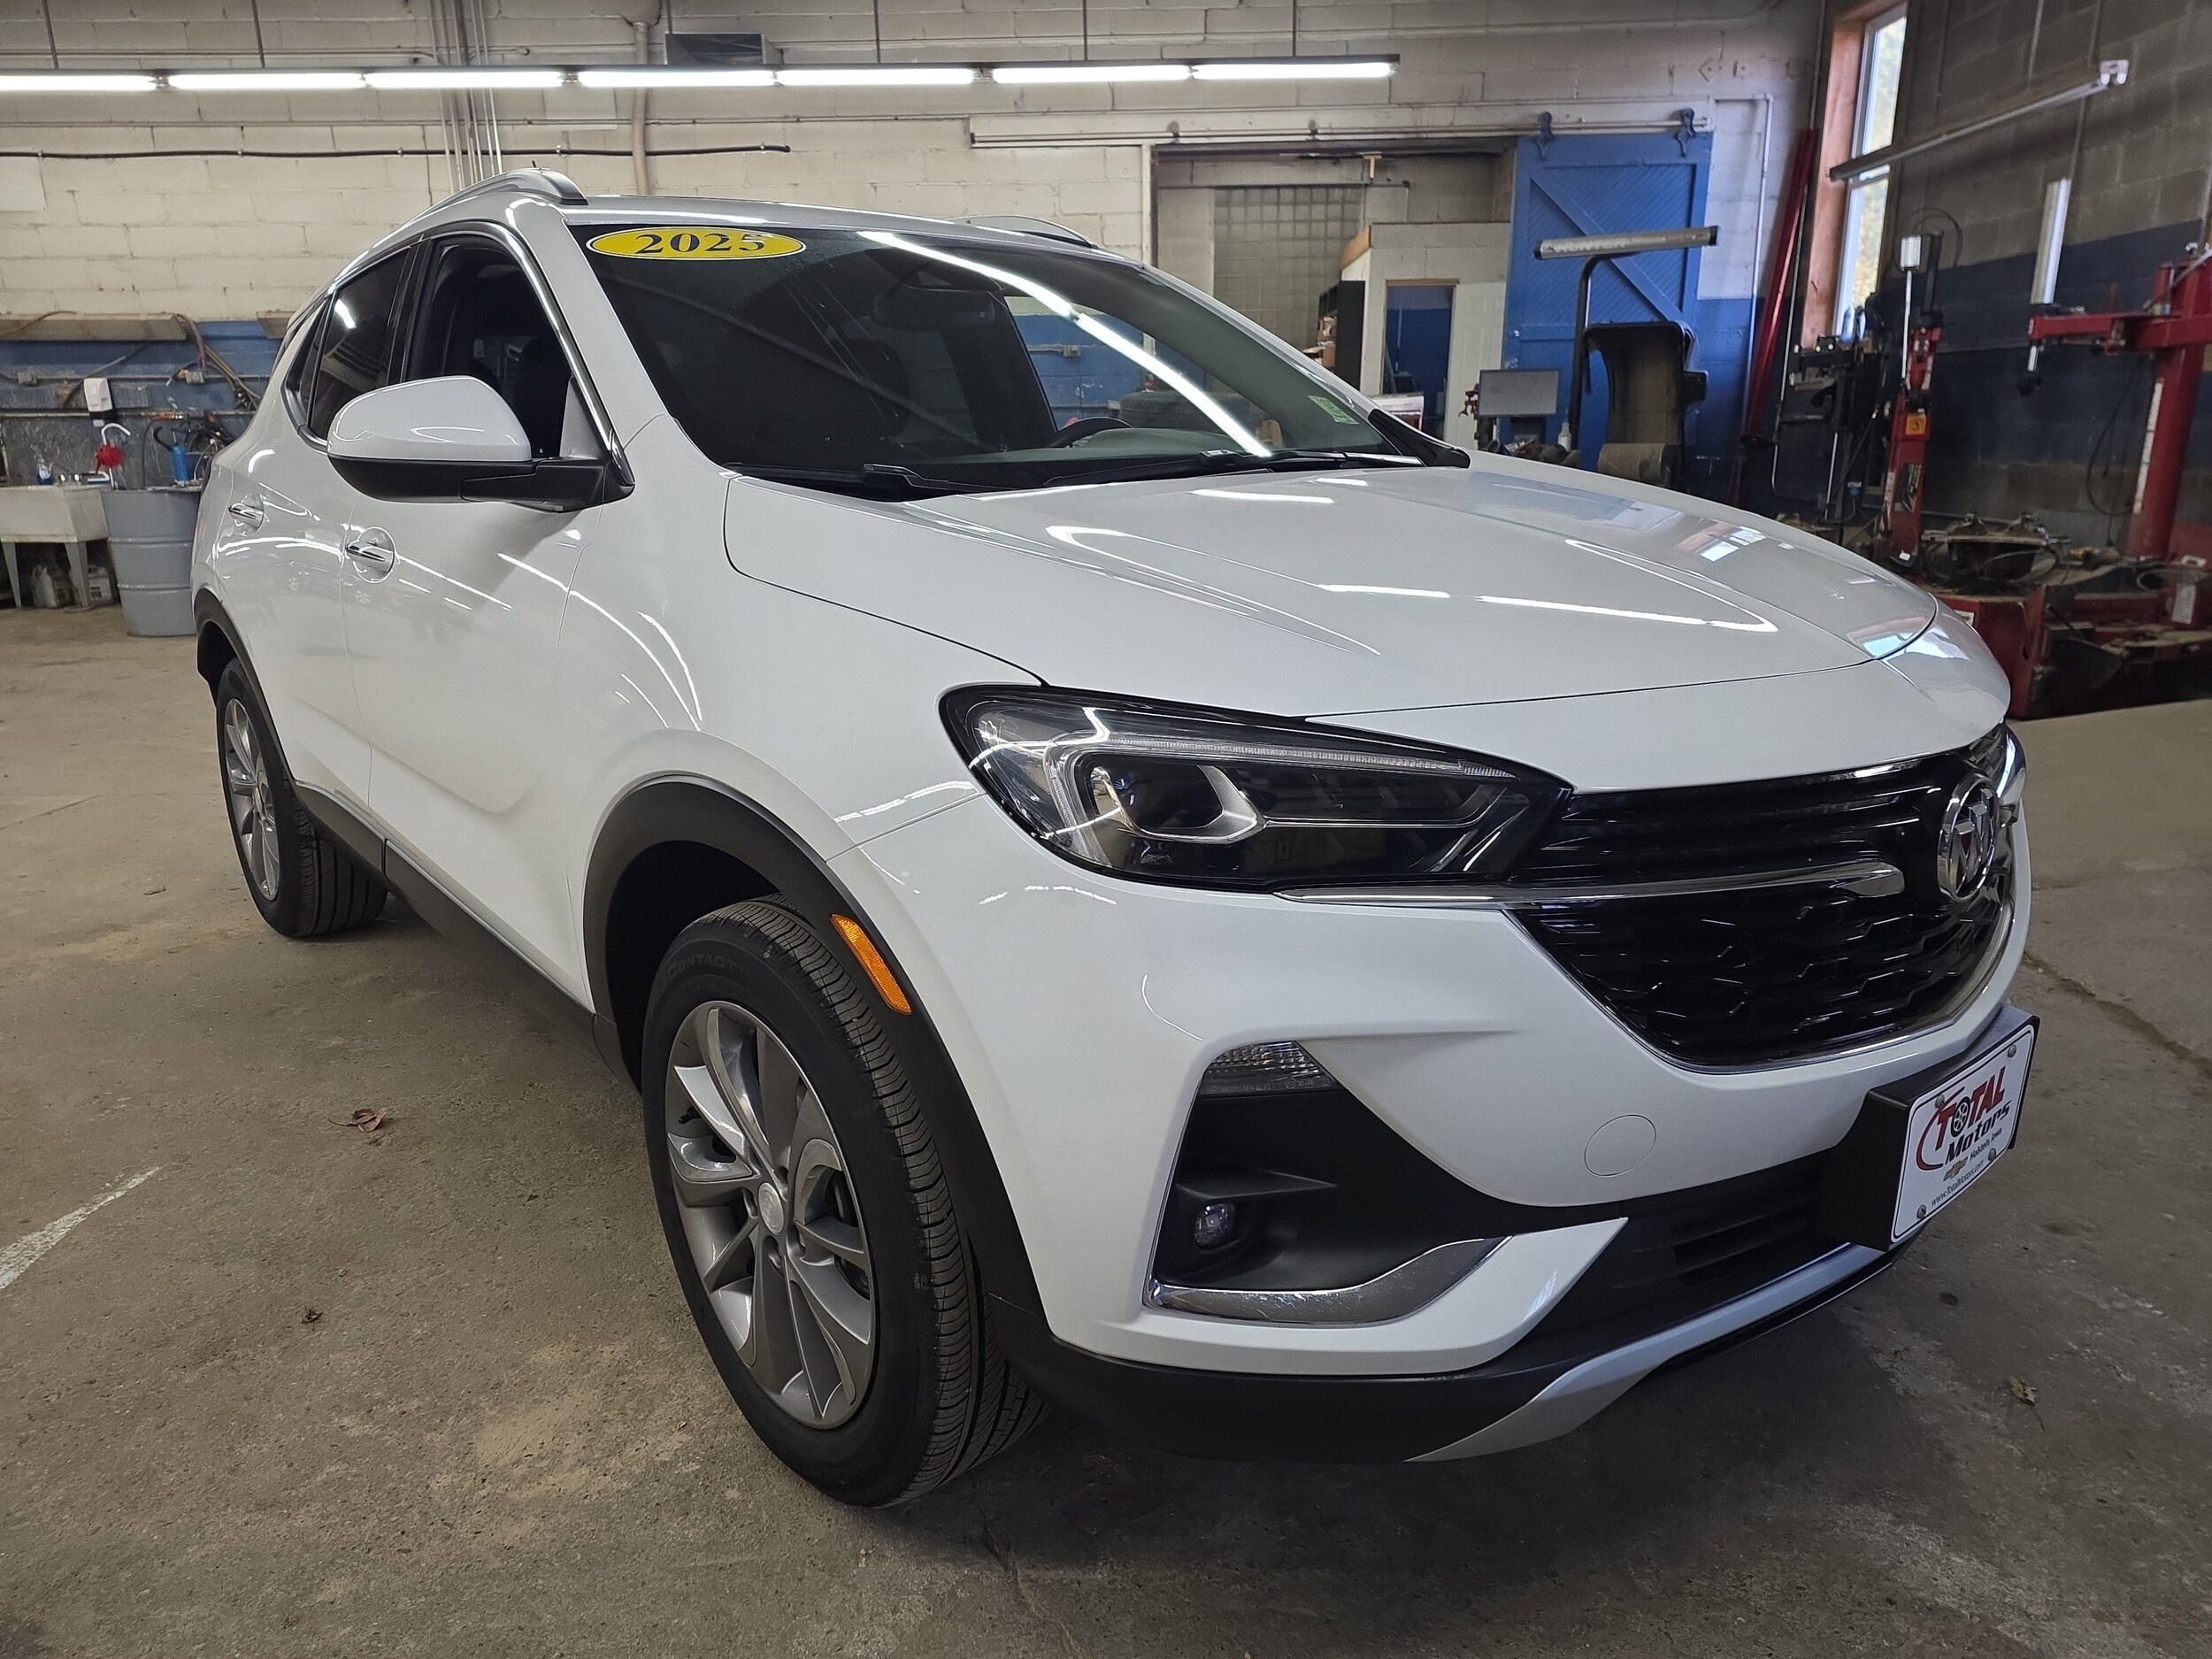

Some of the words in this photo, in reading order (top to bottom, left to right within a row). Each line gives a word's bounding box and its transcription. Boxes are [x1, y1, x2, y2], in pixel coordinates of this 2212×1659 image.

[634, 233, 764, 255] 2025
[1935, 1065, 2006, 1151] TOTAL
[1945, 1100, 2012, 1165] Motors
[1991, 1127, 2002, 1142] Iowa
[1932, 1159, 1984, 1206] www.TotalMotors.com
